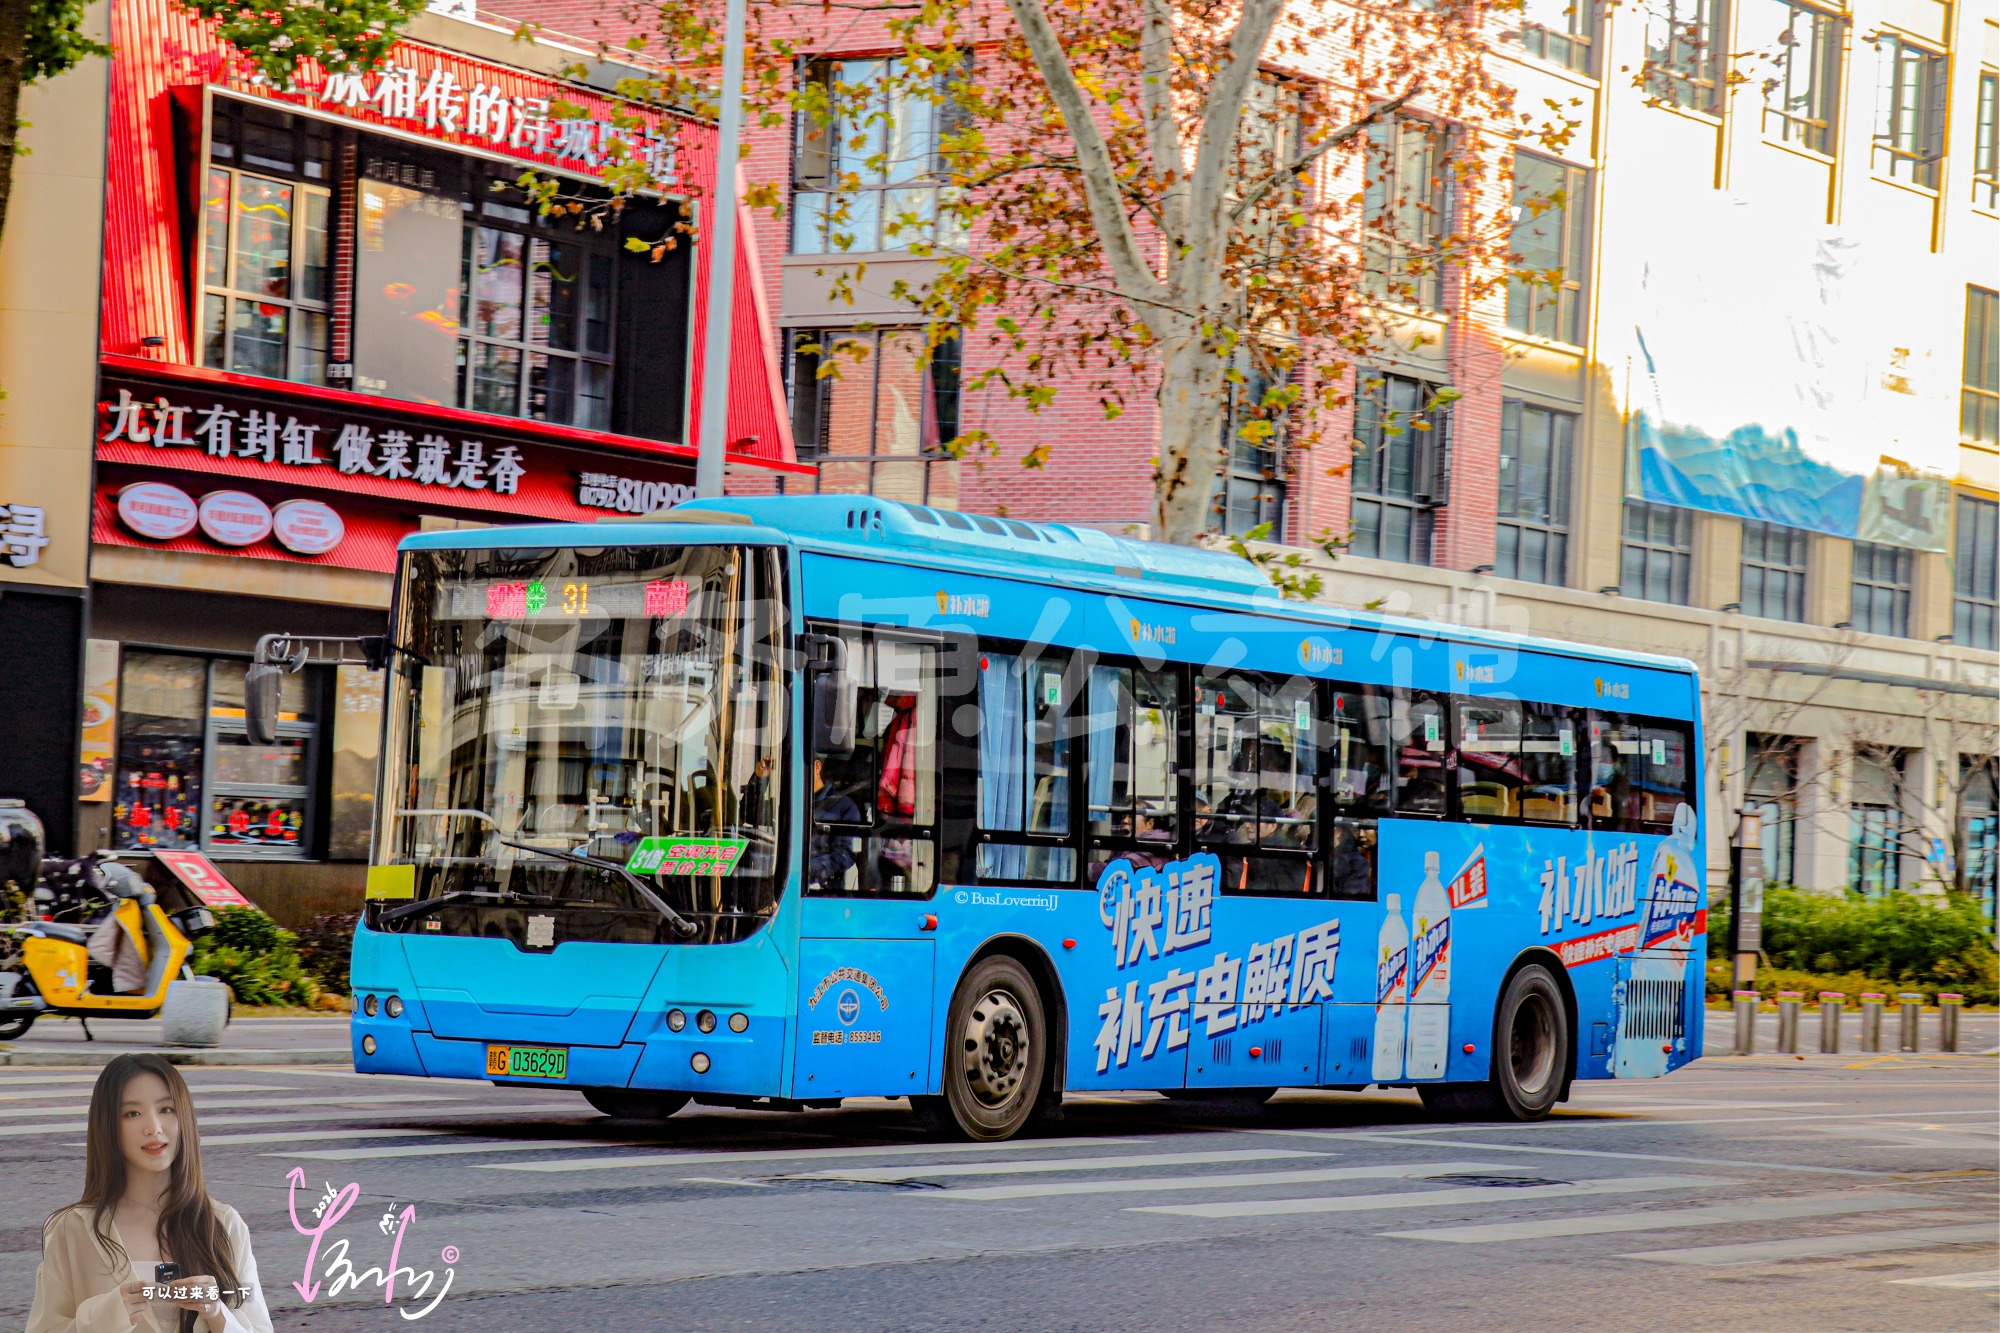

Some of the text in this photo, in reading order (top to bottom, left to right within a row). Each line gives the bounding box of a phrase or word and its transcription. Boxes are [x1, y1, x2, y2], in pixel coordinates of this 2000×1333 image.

[104, 389, 526, 495] 九江有封缸 做菜就是香
[562, 582, 589, 615] 31
[656, 860, 730, 876] 票价2元
[667, 844, 739, 860] 空调开启
[1452, 862, 1485, 907] 1L装
[1539, 841, 1639, 934] 补水啦
[1110, 862, 1216, 969] 快速
[808, 966, 890, 1011] 九江市公共交通集团公司
[1093, 917, 1341, 1074] 补充电解质
[512, 1051, 566, 1074] 03629D
